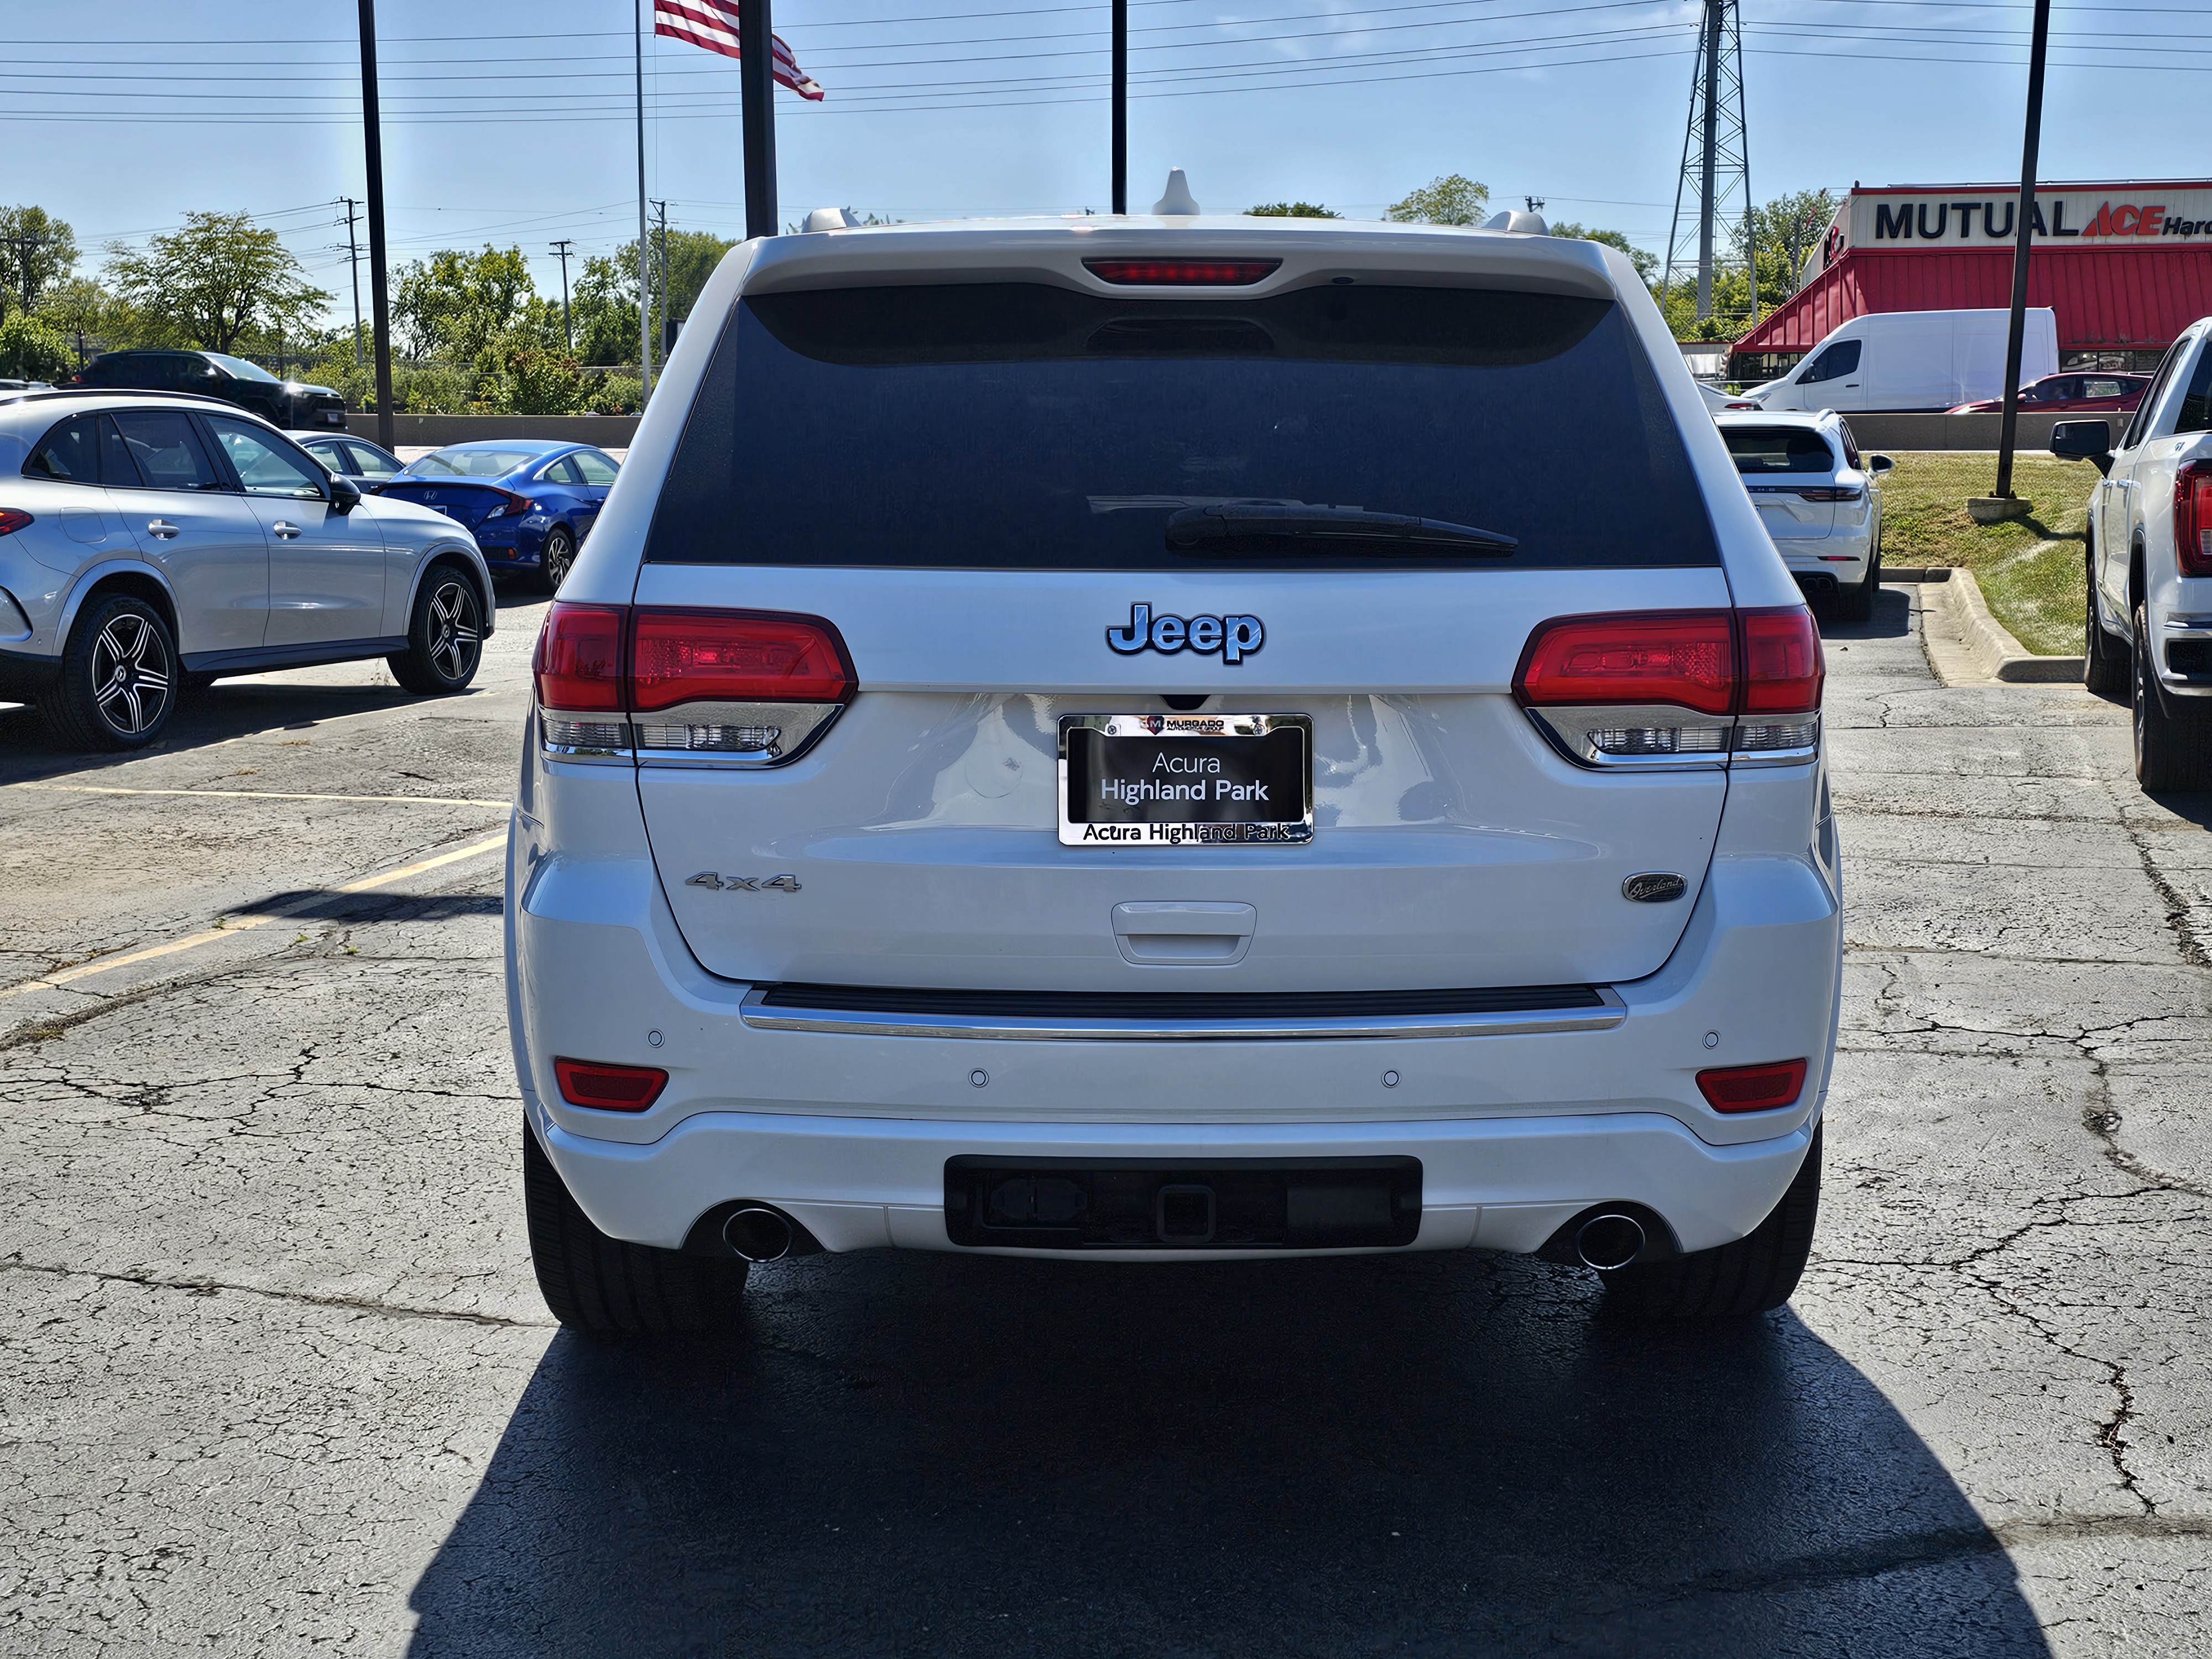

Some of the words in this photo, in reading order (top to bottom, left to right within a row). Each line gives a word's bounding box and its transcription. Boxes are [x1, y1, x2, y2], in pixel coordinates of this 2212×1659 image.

[2081, 201, 2166, 236] ACE
[1105, 602, 1266, 665] Jeep
[1152, 752, 1220, 773] Acura
[1101, 779, 1206, 805] Highland
[1216, 780, 1270, 801] Park
[1083, 823, 1141, 841] Acura
[1149, 823, 1236, 844] Highland
[1244, 823, 1290, 841] Park
[1629, 878, 1681, 898] Overland
